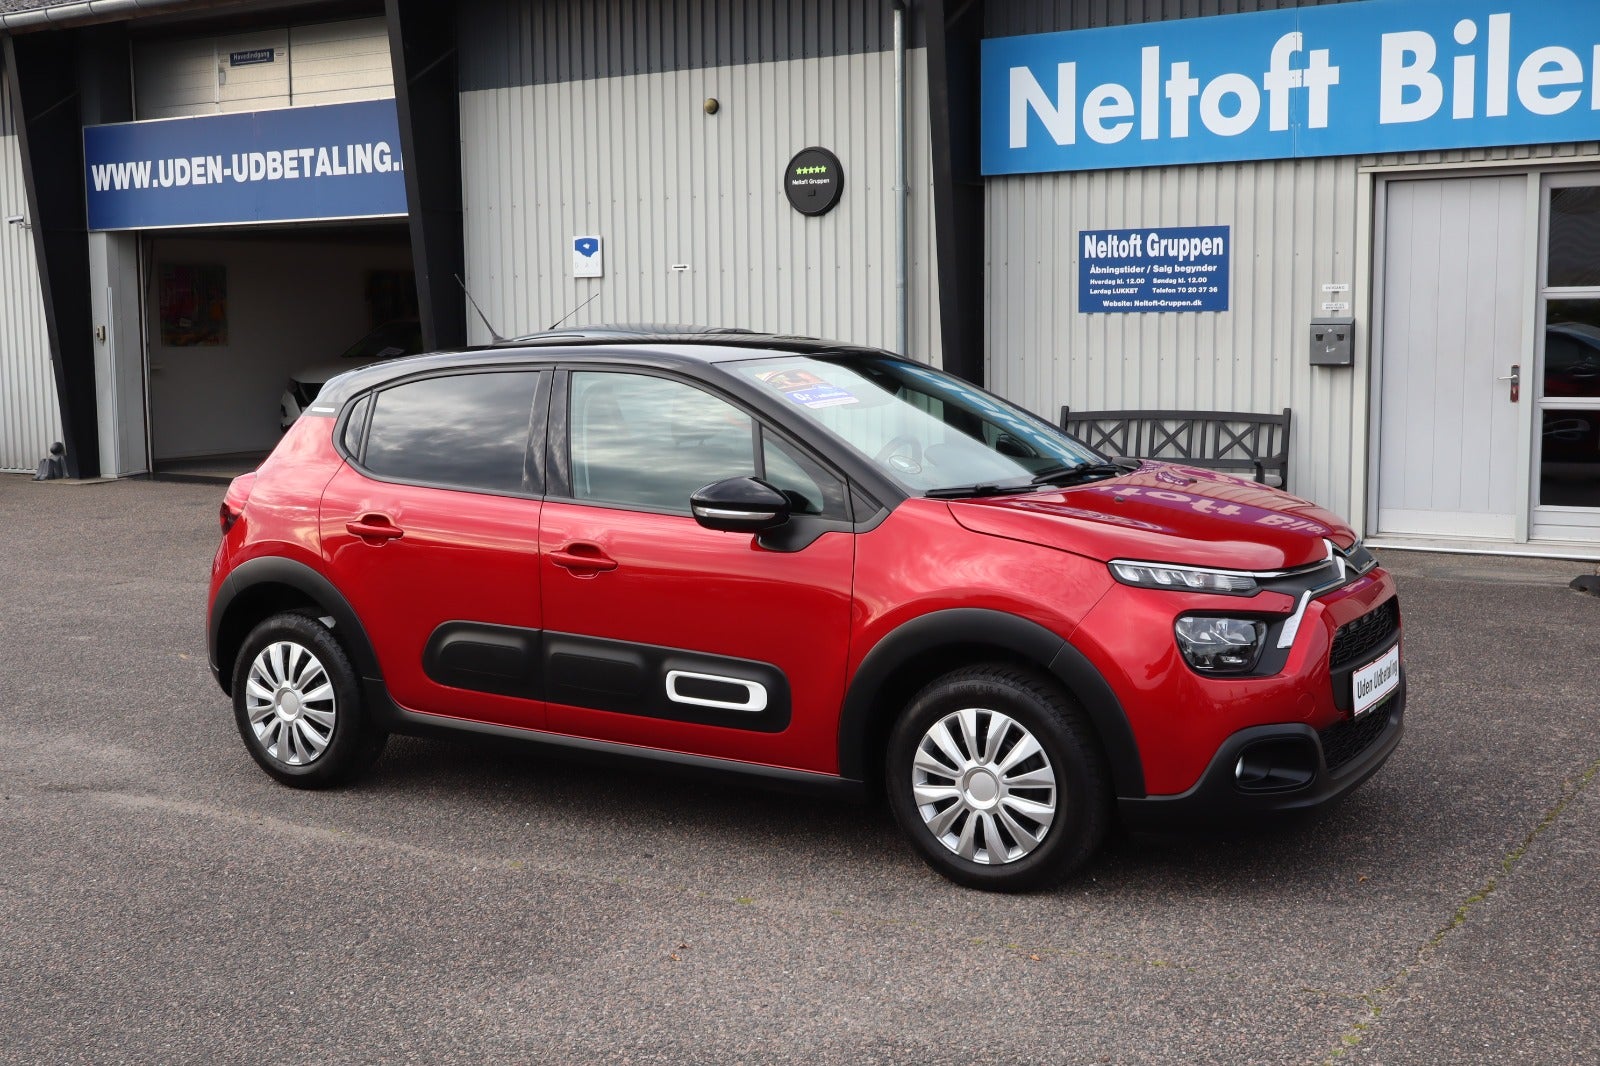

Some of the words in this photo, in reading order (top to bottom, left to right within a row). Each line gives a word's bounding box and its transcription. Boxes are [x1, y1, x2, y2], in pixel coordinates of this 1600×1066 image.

[1009, 31, 1340, 149] Neltoft
[91, 141, 404, 192] WWW.UDEN-UDBETALING.
[1084, 234, 1142, 258] Neltoft
[1147, 232, 1223, 261] Gruppen
[1089, 264, 1145, 275] Åbningstider
[1146, 264, 1151, 274] /
[1152, 264, 1173, 274] Salg
[1174, 263, 1217, 274] begynder
[1133, 299, 1203, 308] Neltoft-Gruppen.dk
[1357, 678, 1373, 699] Uden
